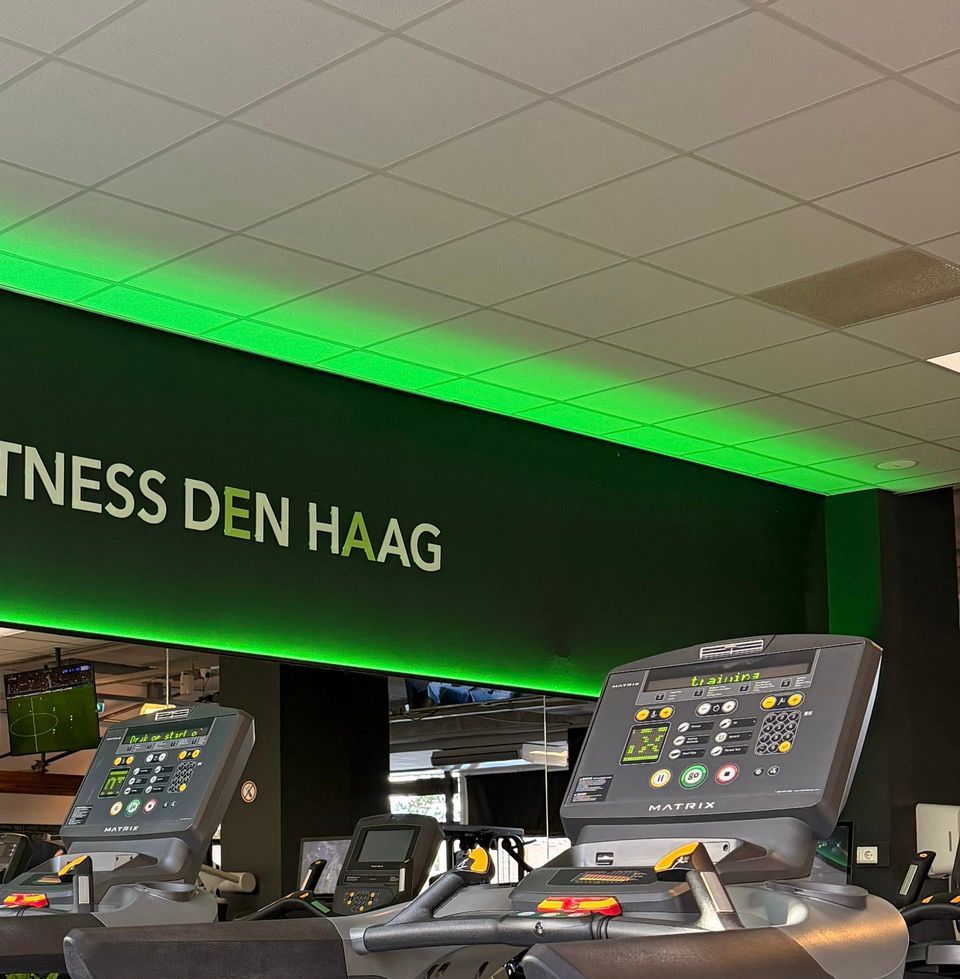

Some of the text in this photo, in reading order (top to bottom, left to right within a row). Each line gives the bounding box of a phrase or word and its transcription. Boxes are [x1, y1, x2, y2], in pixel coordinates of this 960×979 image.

[184, 477, 289, 548] DEN
[308, 502, 441, 572] HAAG
[648, 801, 716, 812] MATRIX
[103, 825, 139, 833] MATRIX
